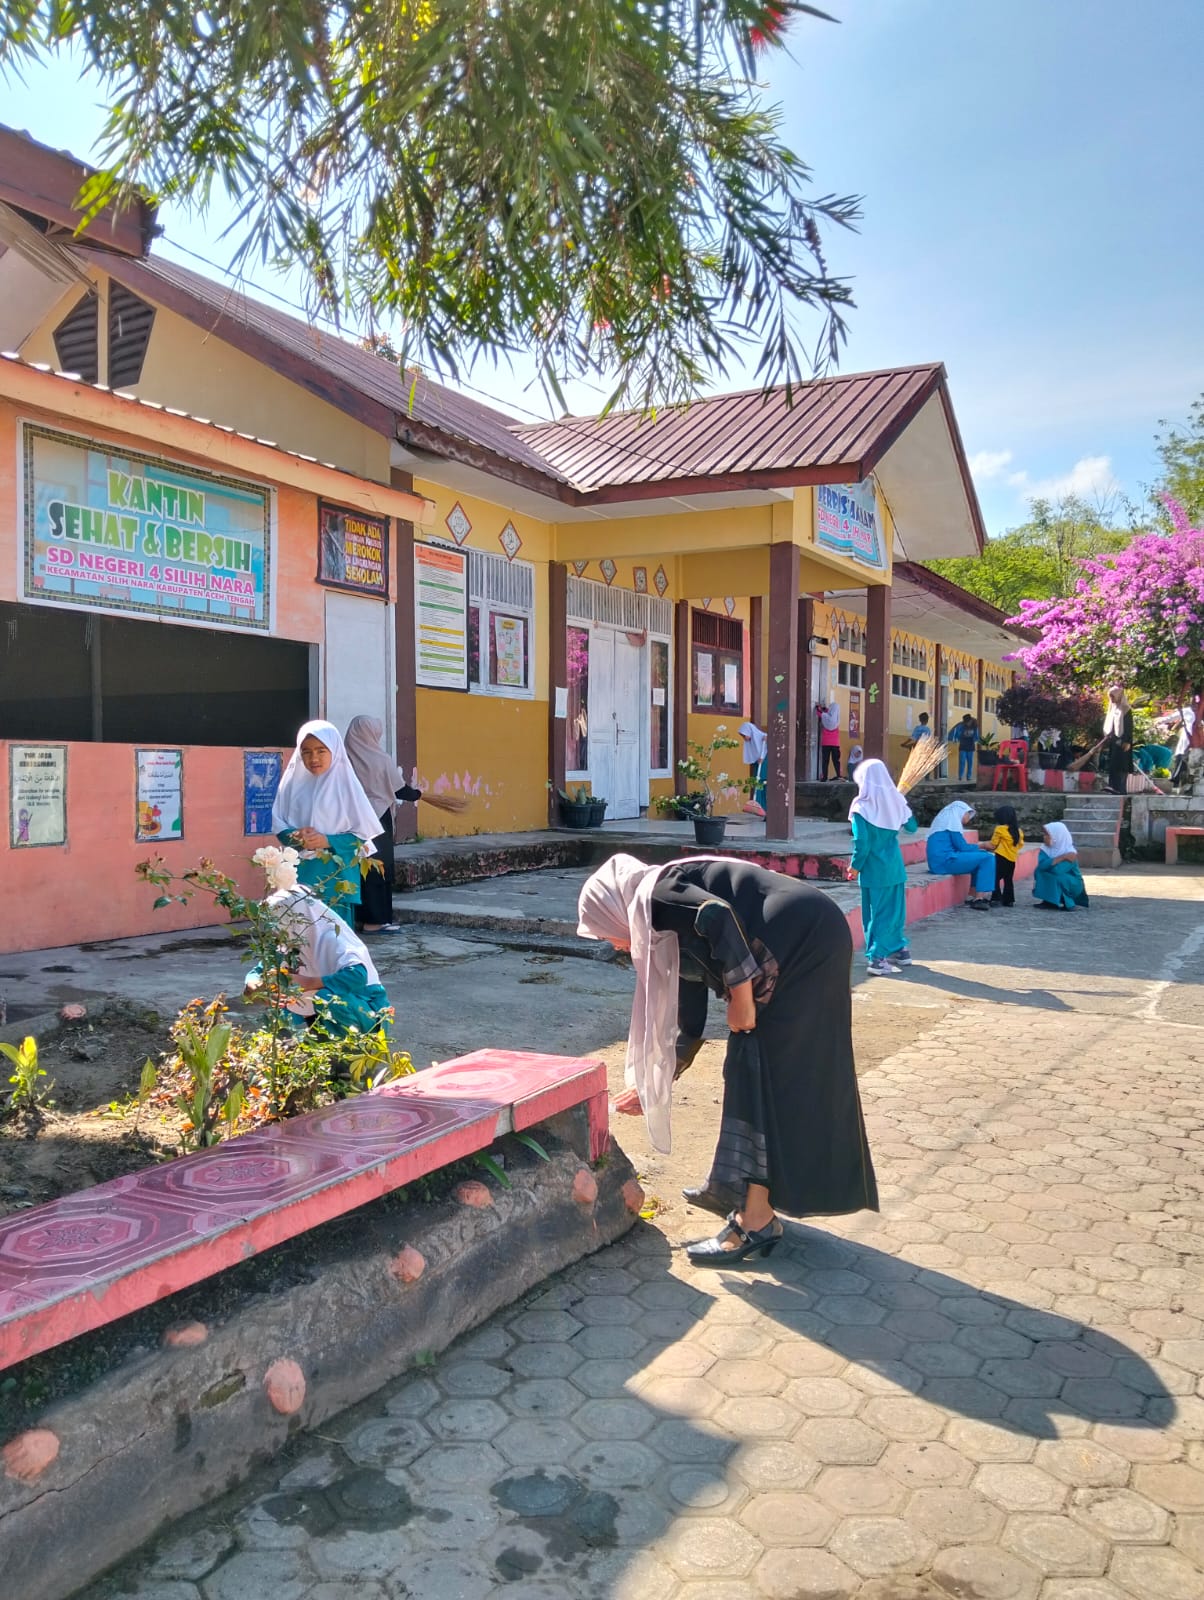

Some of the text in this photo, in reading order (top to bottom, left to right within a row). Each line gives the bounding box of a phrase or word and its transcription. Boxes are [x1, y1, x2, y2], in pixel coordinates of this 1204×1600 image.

[108, 471, 204, 525] KANTIN
[49, 502, 252, 571] SEHAT & BERSIH
[345, 519, 366, 536] TIDAK
[843, 520, 849, 530] 4
[345, 541, 381, 562] MEROKOK
[47, 566, 254, 605] KECAMATAN SILIH NARA KABUPATEN ACEH TENGAH
[48, 547, 254, 595] SD NEGERI 4 SILIH NARA
[346, 565, 383, 585] SEKOLAH
